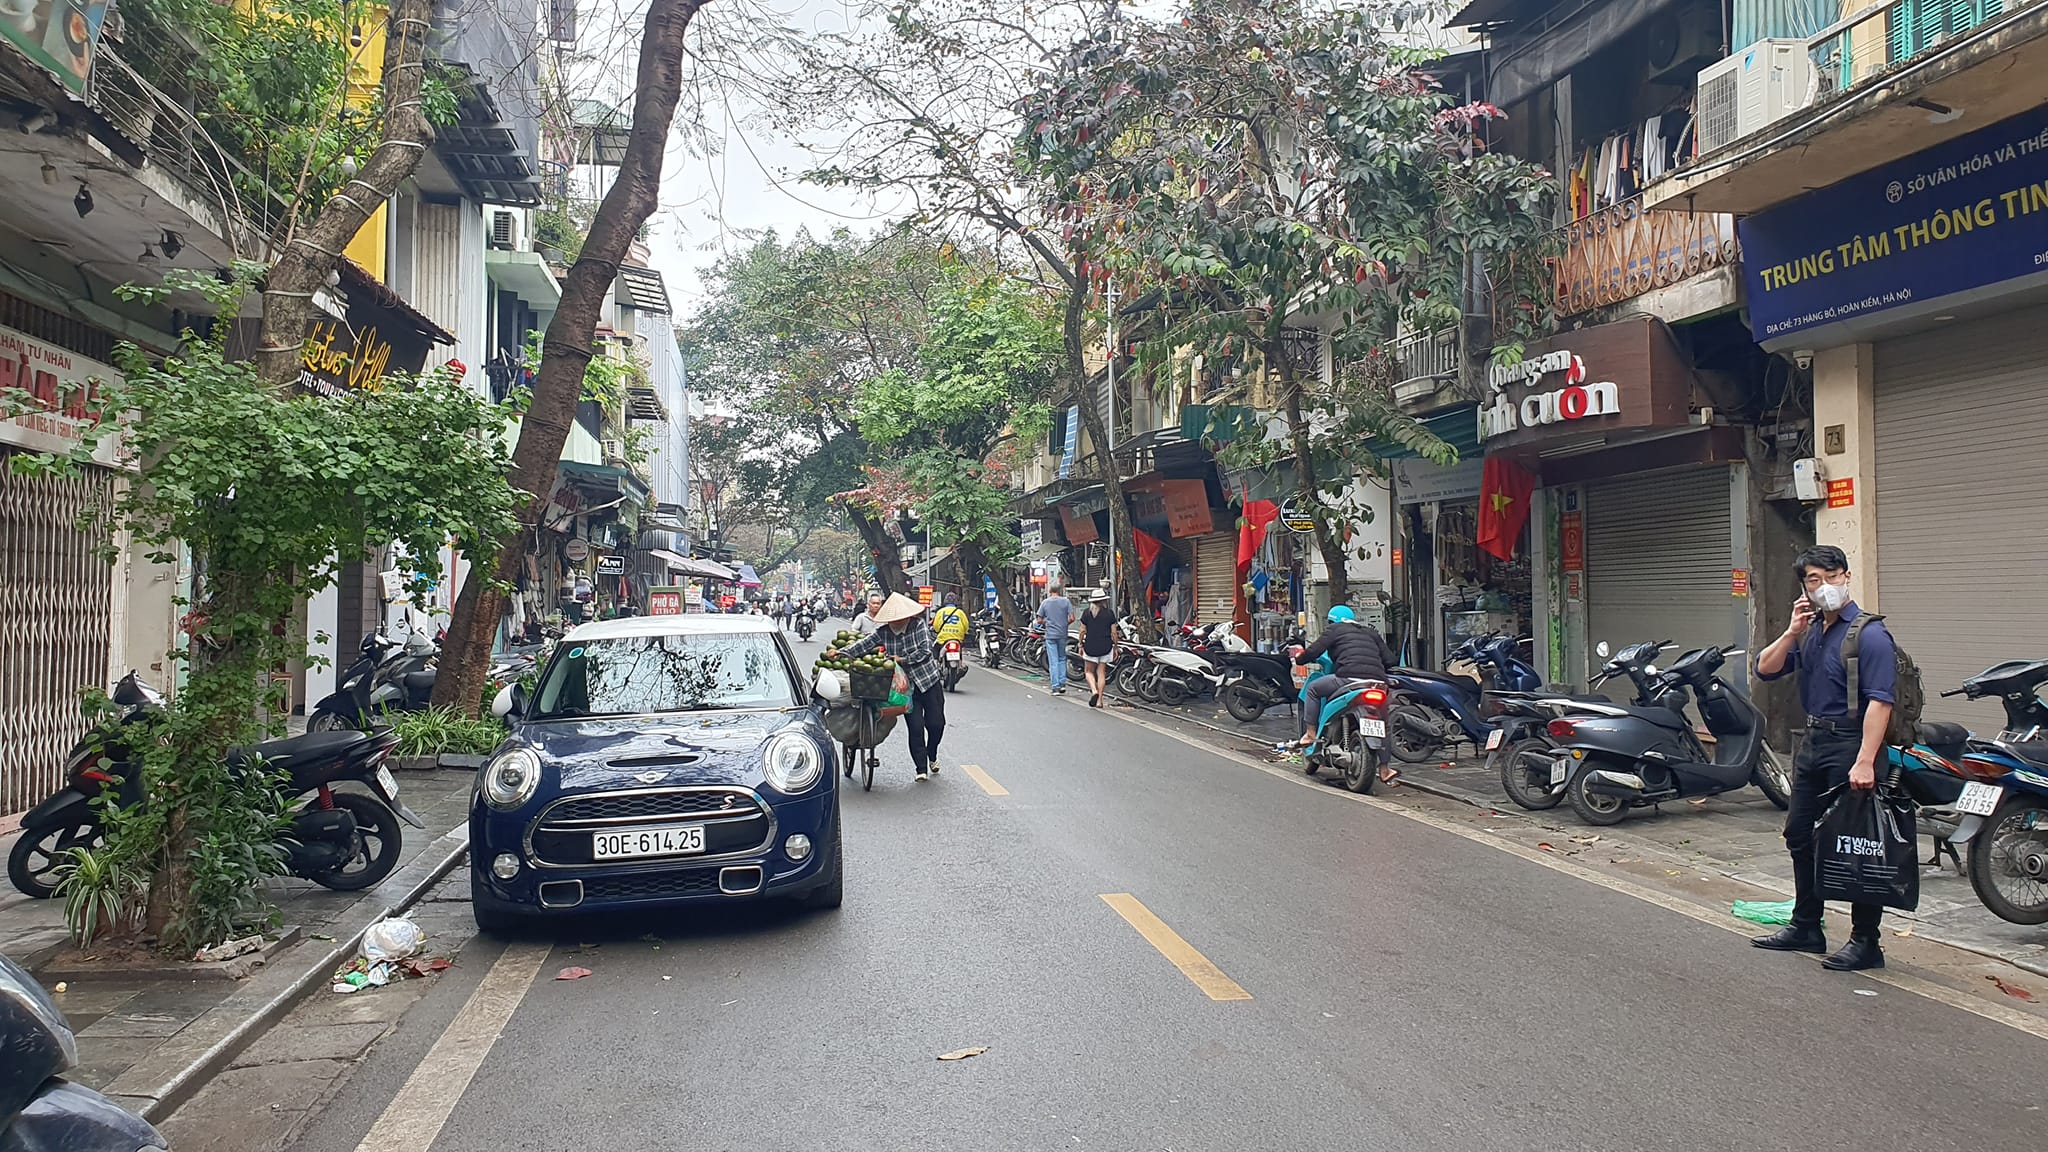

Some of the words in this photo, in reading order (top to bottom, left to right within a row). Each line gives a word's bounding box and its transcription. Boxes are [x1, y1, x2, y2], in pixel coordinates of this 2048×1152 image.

[1907, 174, 1926, 194] SỞ
[1927, 168, 1957, 186] VĂN
[1960, 154, 1993, 176] HÓA
[1994, 143, 2017, 163] VÀ
[1760, 250, 1834, 292] TRUNG
[1837, 231, 1891, 269] TÂM
[1894, 199, 1996, 251] THÔNG
[2000, 179, 2048, 219] TIN
[1793, 317, 1801, 326] 73
[1837, 302, 1860, 315] HOÀN
[1882, 292, 1896, 304] HÀ
[44, 350, 71, 370] NHÂN
[1827, 431, 1841, 447] 73
[652, 595, 668, 608] PHỞ
[669, 596, 680, 608] GÀ
[942, 610, 960, 625] be
[1958, 797, 1994, 814] 681.55
[596, 829, 702, 855] 30E-614.25
[1851, 836, 1883, 848] Whey
[1852, 845, 1884, 857] Store
